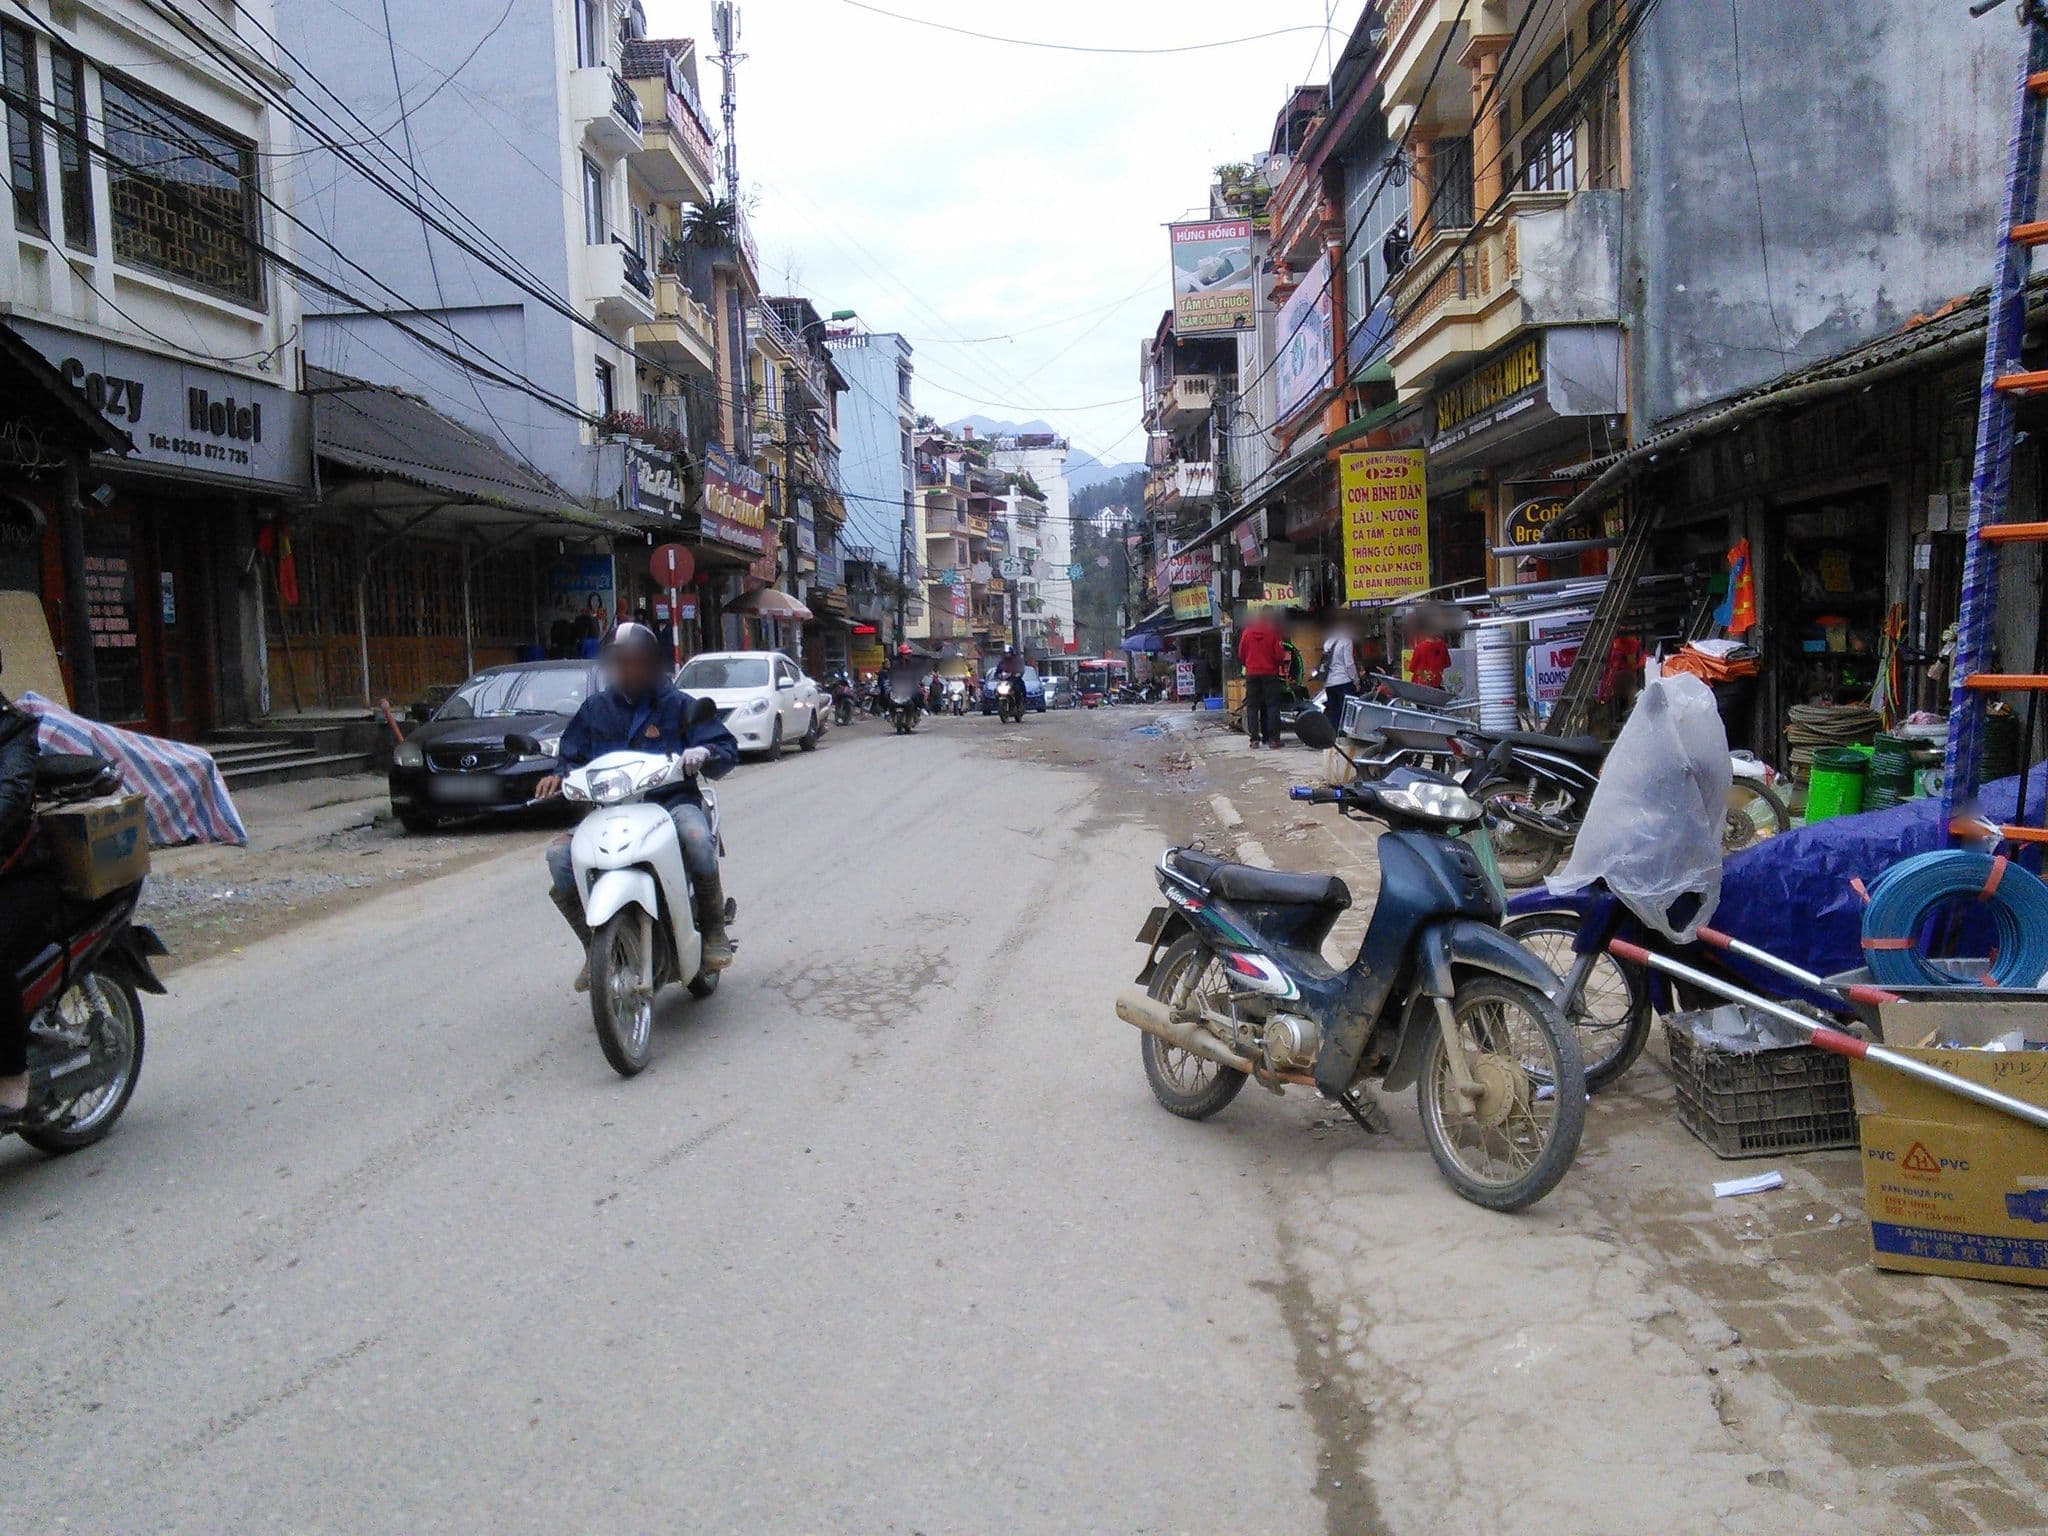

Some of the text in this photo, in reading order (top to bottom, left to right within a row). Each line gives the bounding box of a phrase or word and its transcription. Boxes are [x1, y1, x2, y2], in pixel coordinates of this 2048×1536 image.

[1437, 388, 1463, 432] SAPA
[1504, 340, 1540, 396] HOTEL
[189, 386, 262, 444] Hotel
[1366, 466, 1408, 480] 029
[1538, 670, 1567, 685] ROOMS
[1868, 1149, 1970, 1171] PVC PVC
[1967, 1235, 2028, 1249] PLASTIC
